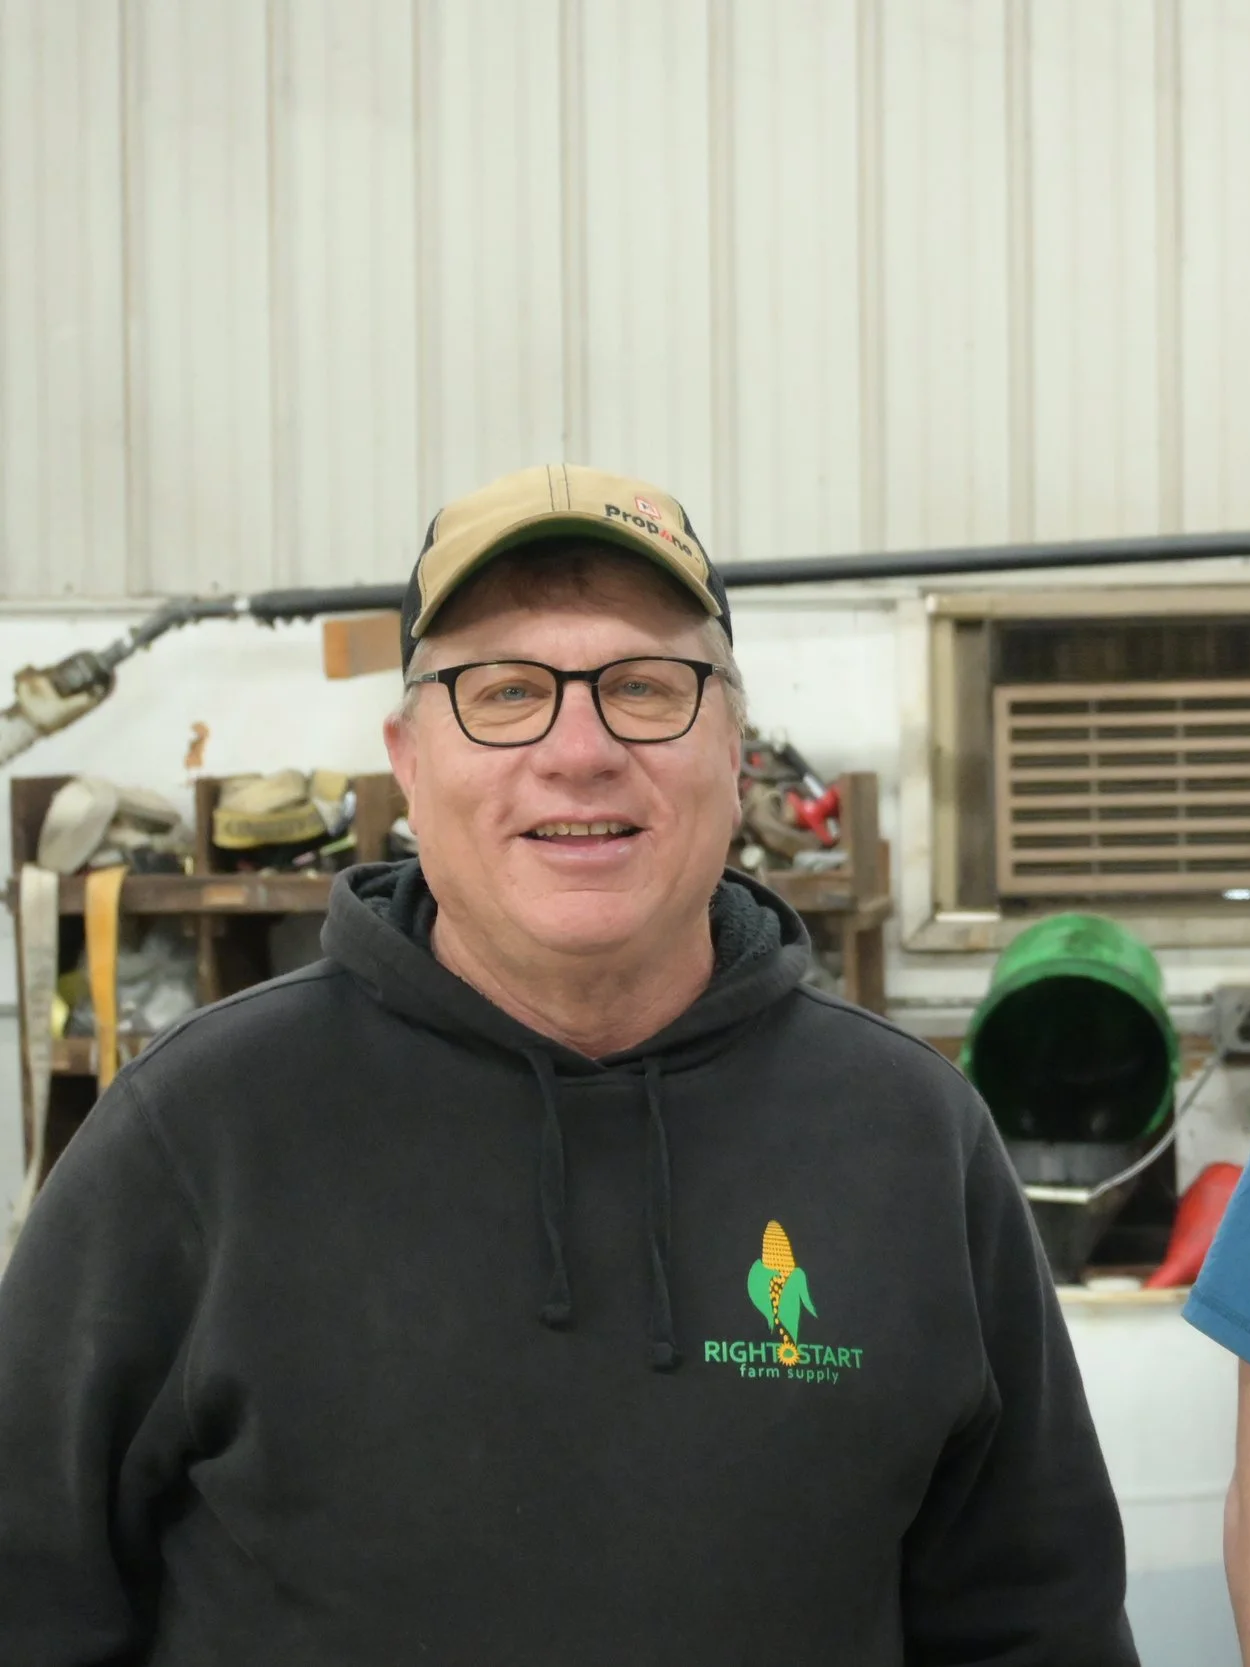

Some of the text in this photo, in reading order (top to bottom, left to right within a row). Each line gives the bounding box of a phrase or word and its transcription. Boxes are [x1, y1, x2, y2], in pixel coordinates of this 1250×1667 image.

[704, 1340, 863, 1369] RIGHT START
[739, 1363, 839, 1385] farm supply
